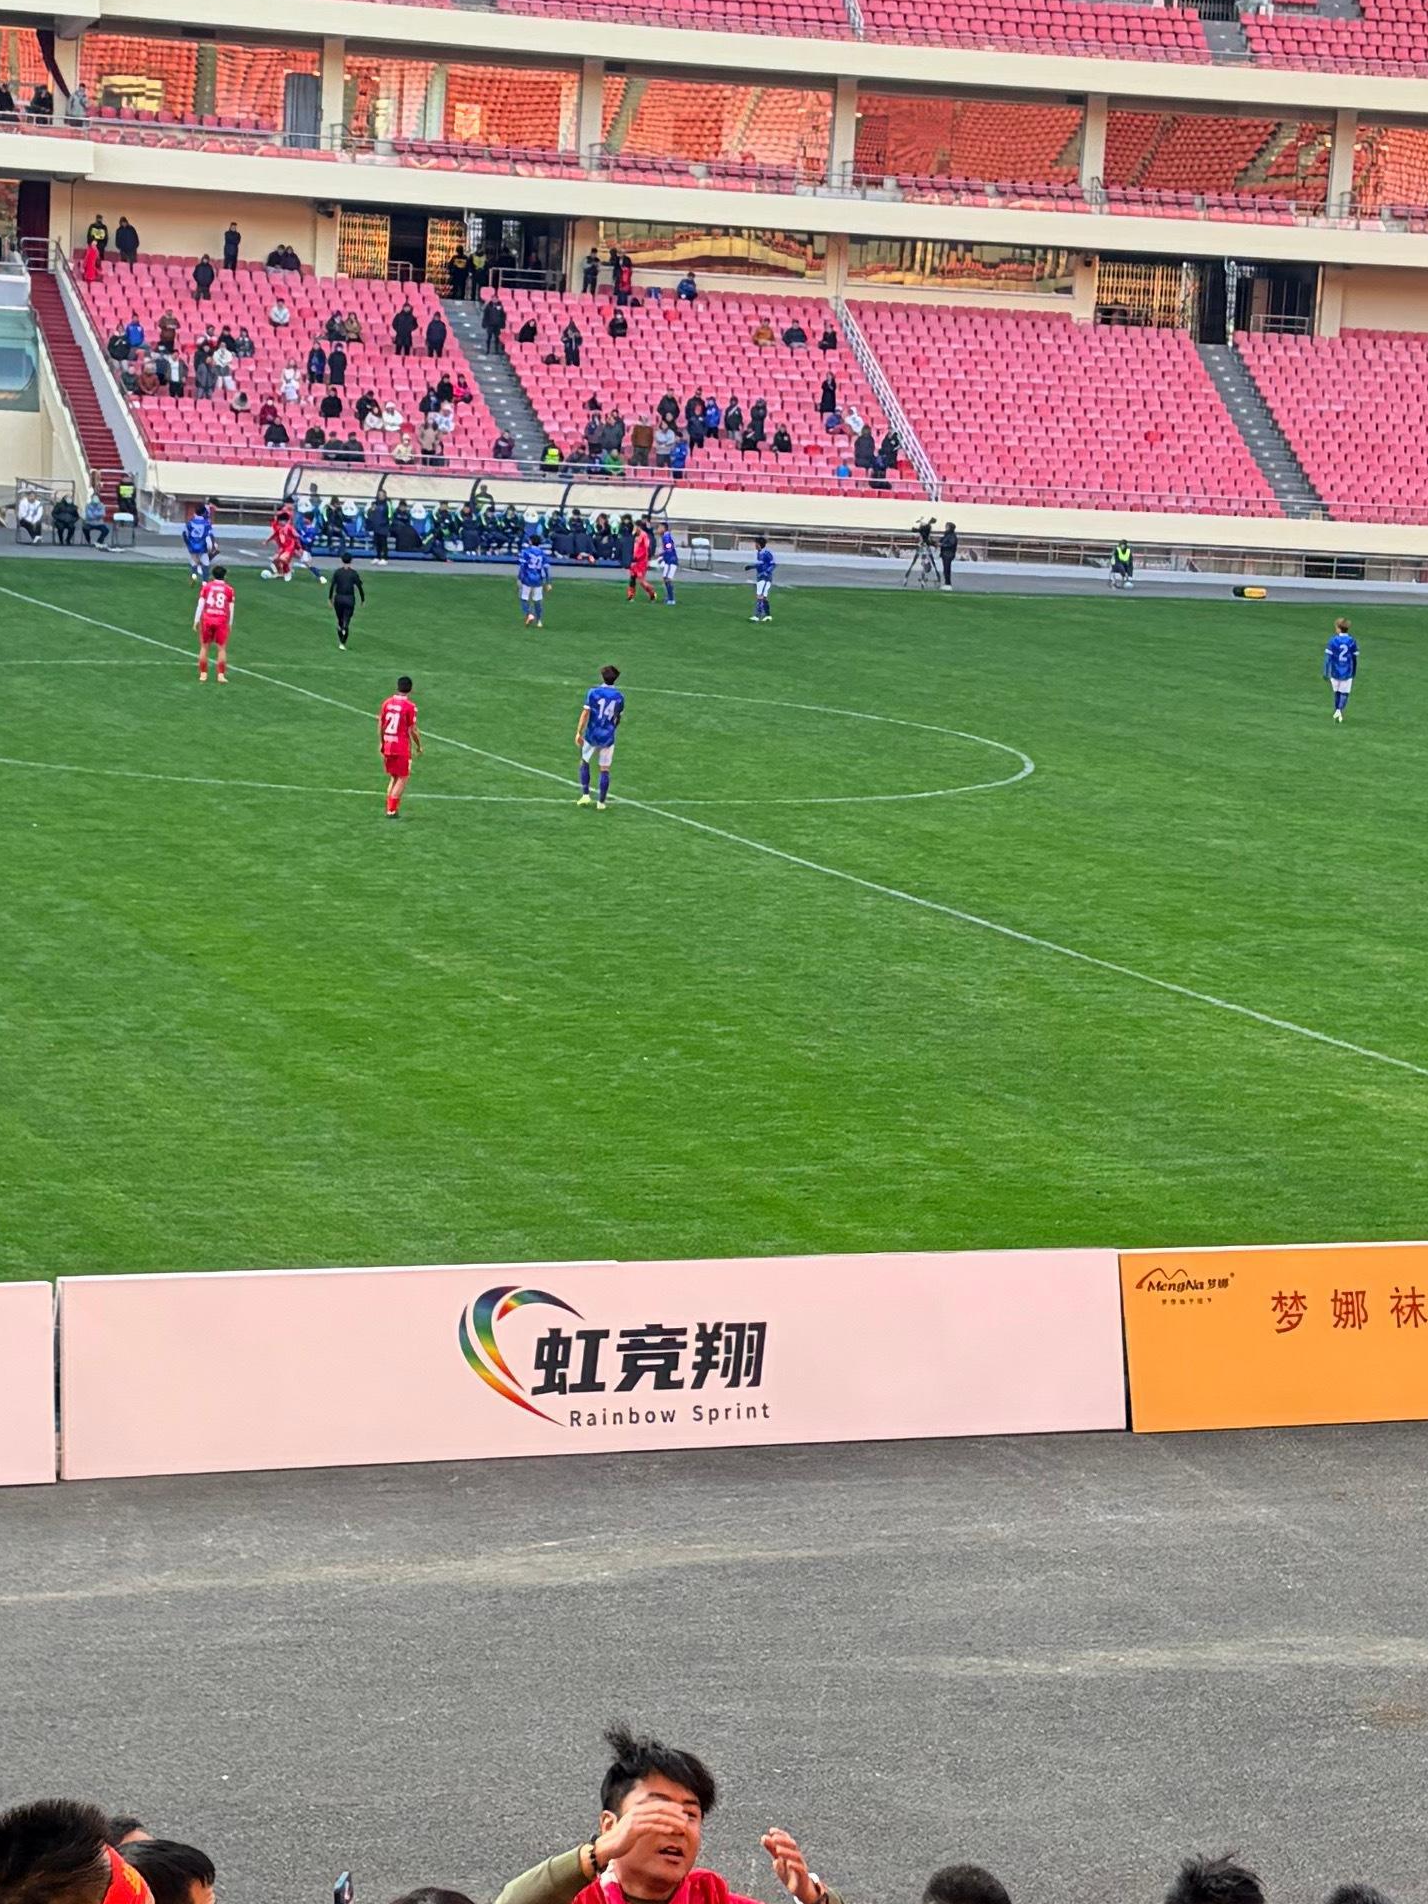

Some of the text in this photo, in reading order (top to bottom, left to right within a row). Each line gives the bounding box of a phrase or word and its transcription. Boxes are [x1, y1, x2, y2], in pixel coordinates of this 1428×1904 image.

[206, 591, 227, 609] 48
[1338, 643, 1349, 662] 2
[597, 698, 617, 721] 14
[1146, 1279, 1204, 1293] MengNa
[530, 1321, 768, 1396] 虹竞翔
[570, 1402, 771, 1428] Rainbow Sprint
